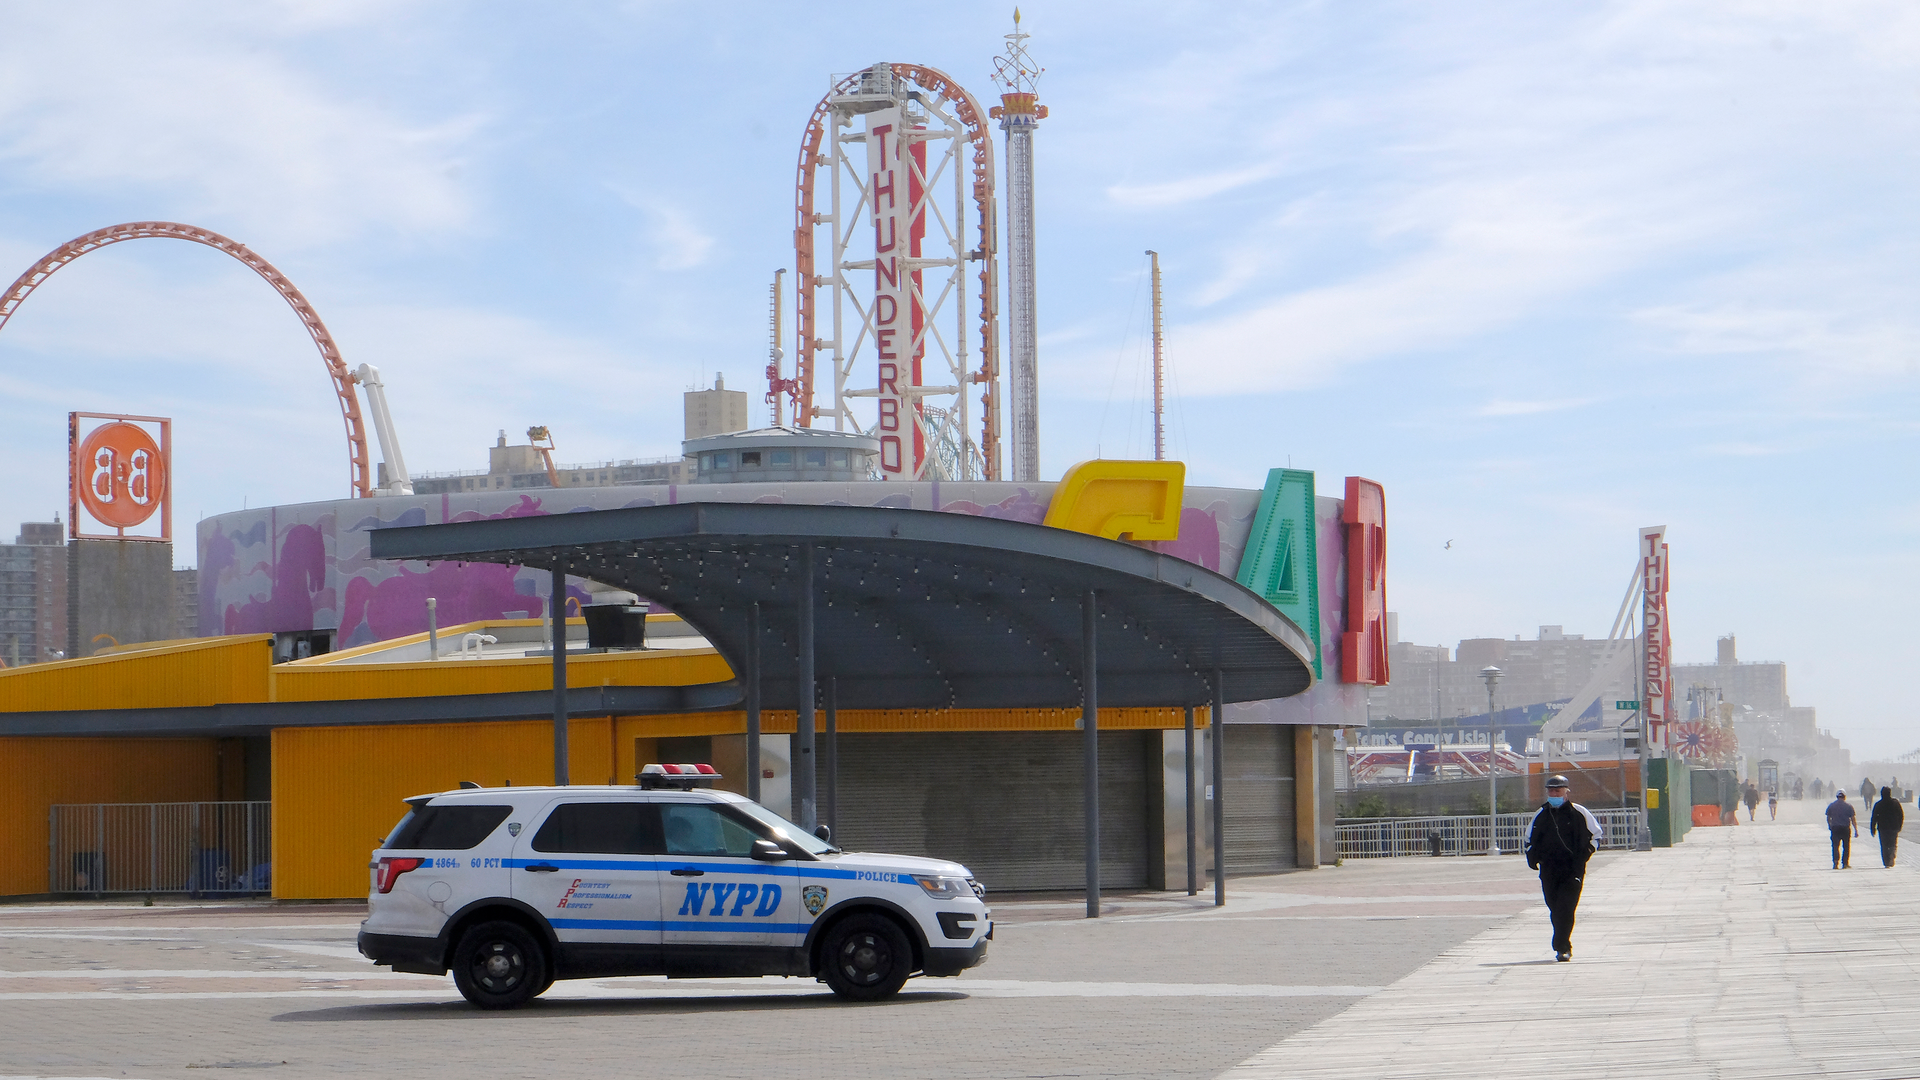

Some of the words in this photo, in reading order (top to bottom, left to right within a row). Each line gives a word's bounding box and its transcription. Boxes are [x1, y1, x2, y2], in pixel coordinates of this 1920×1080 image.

[872, 123, 902, 481] THUNDERBO
[1643, 532, 1664, 743] THUNDERBOLT
[1546, 702, 1568, 710] Tom'
[1355, 731, 1397, 746] Tom's
[435, 858, 456, 868] 4864
[470, 858, 481, 868] 60
[484, 858, 500, 868] PCT
[857, 871, 897, 883] POLICE
[571, 878, 611, 889] COURTESY
[564, 888, 633, 899] PROFESSIONALISM
[556, 898, 594, 909] RESPECT
[678, 882, 782, 917] NYPD
